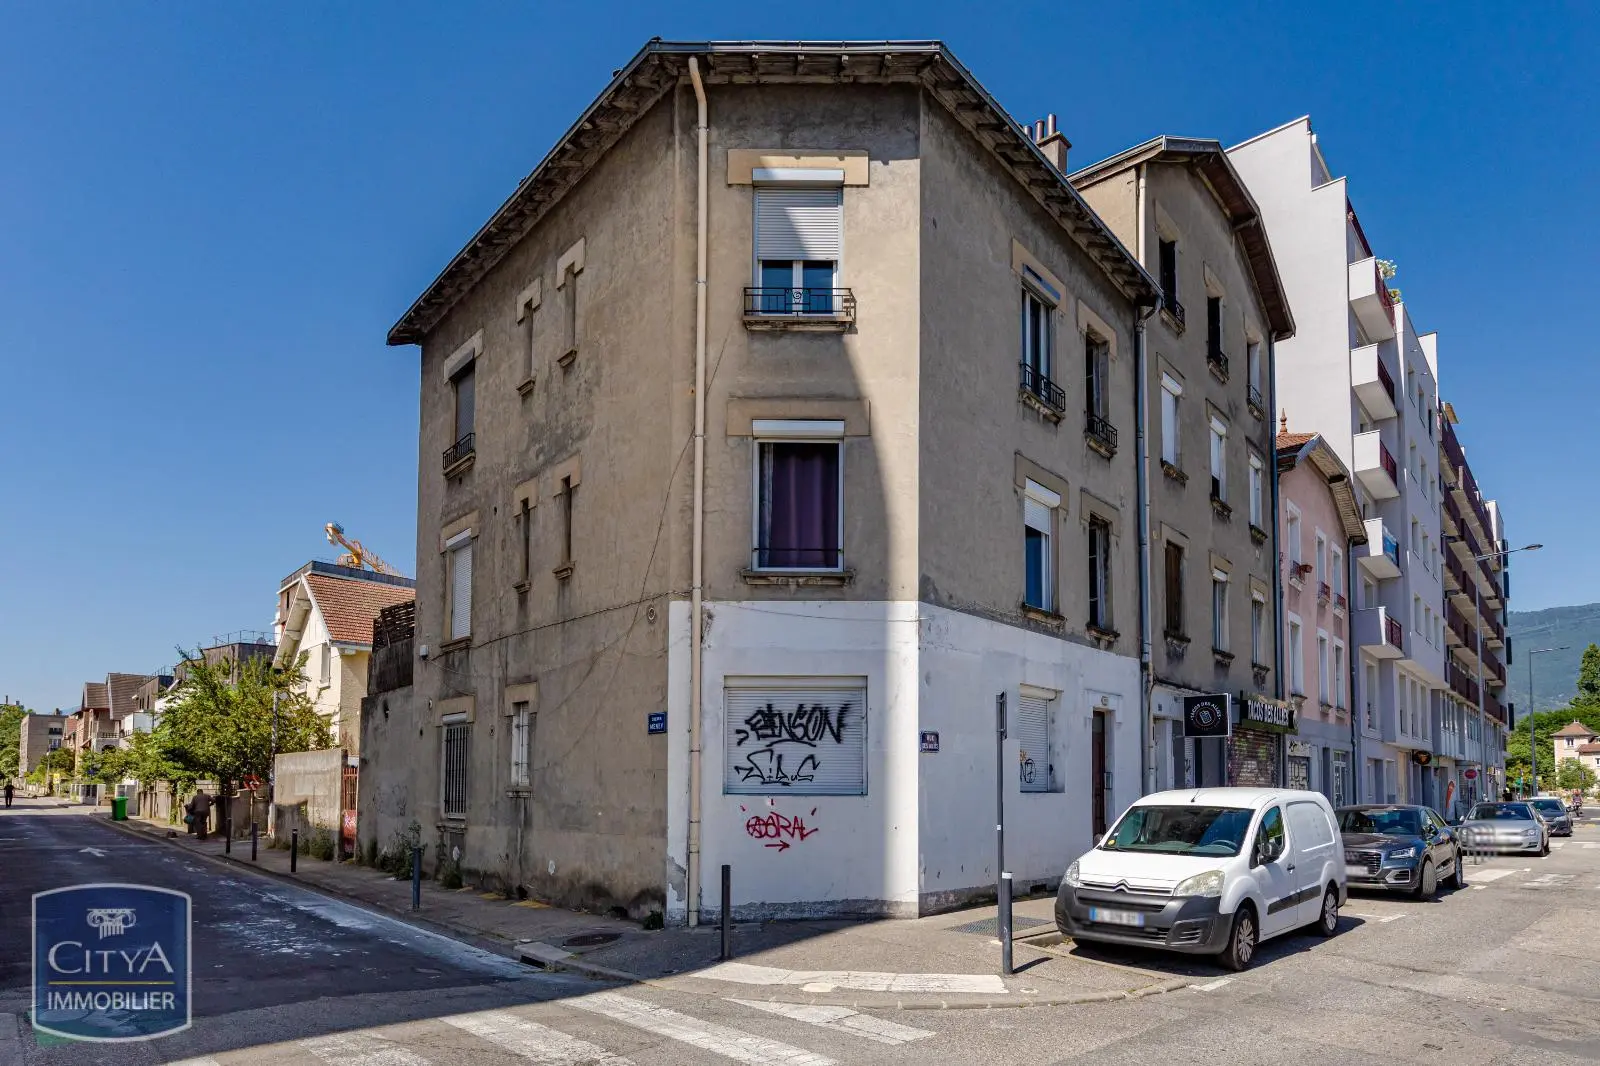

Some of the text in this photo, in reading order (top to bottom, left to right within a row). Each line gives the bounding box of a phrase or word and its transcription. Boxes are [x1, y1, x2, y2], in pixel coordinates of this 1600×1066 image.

[1190, 703, 1201, 719] TACOS
[1248, 699, 1263, 722] TACOS
[1264, 703, 1273, 724] DES
